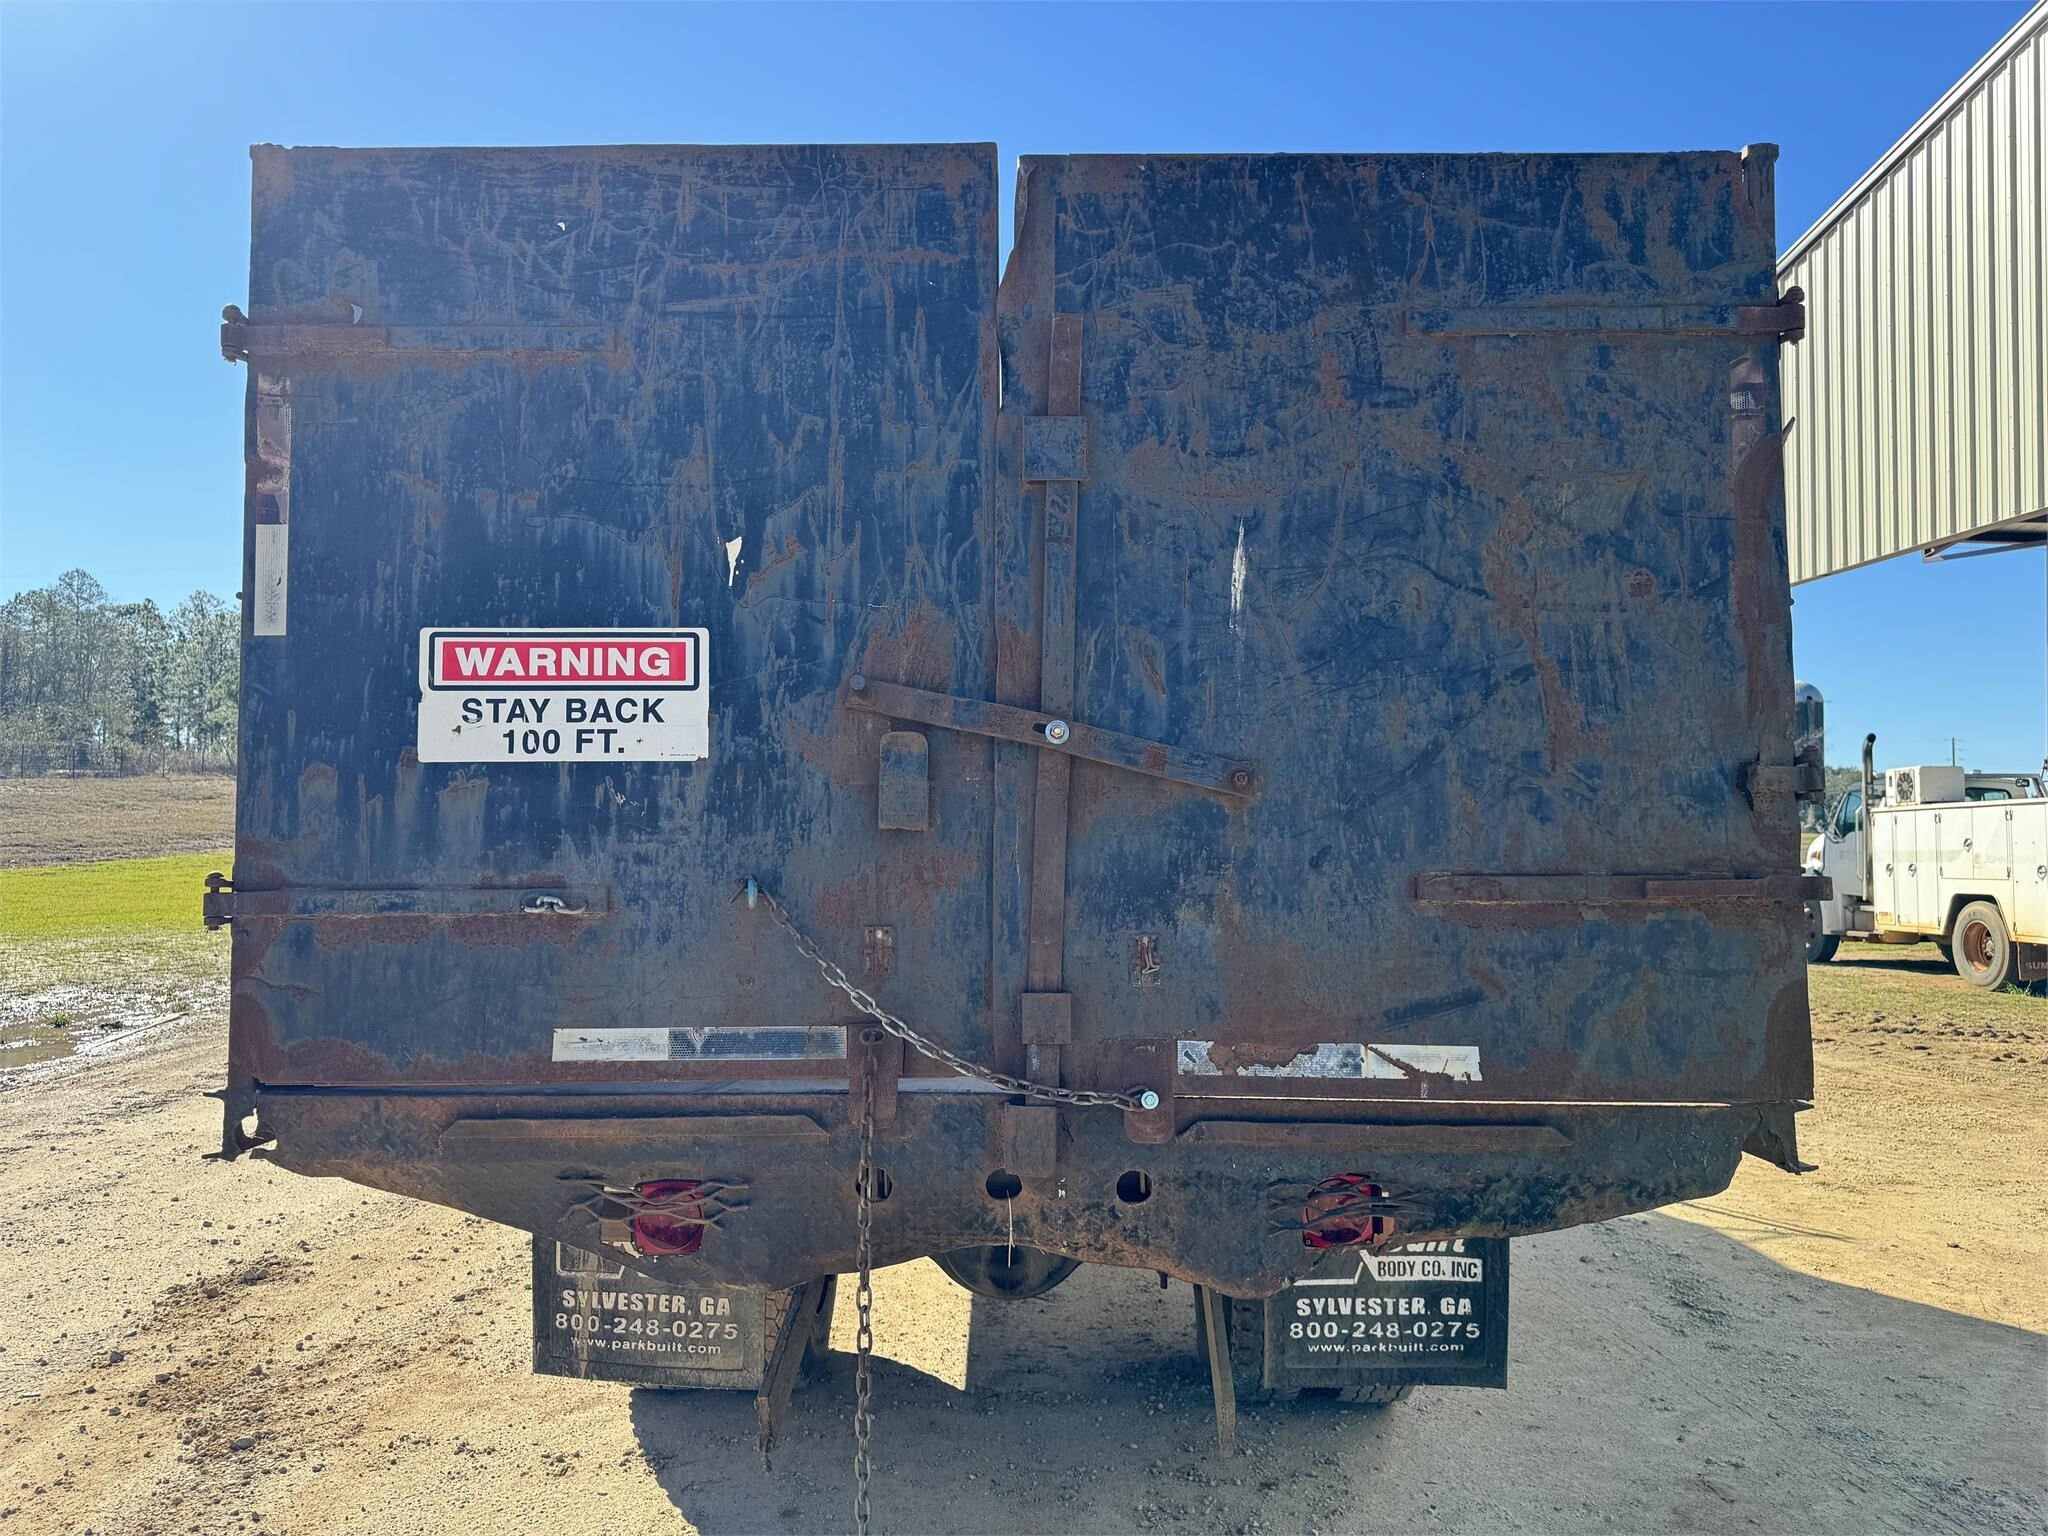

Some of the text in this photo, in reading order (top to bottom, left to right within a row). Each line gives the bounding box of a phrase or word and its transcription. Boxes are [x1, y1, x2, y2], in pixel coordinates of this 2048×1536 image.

[455, 647, 671, 677] WARNING
[461, 698, 665, 724] STAY BACK
[502, 728, 625, 754] 100 FT.
[1377, 1260, 1416, 1277] BODY
[1451, 1261, 1478, 1279] INC
[562, 1289, 731, 1316] SYLVESTER, GA
[1440, 1297, 1472, 1316] GA
[555, 1313, 738, 1340] 800-248-0275
[1289, 1321, 1481, 1339] 800-248-0275
[1307, 1342, 1465, 1354] www.parkbuilt.com
